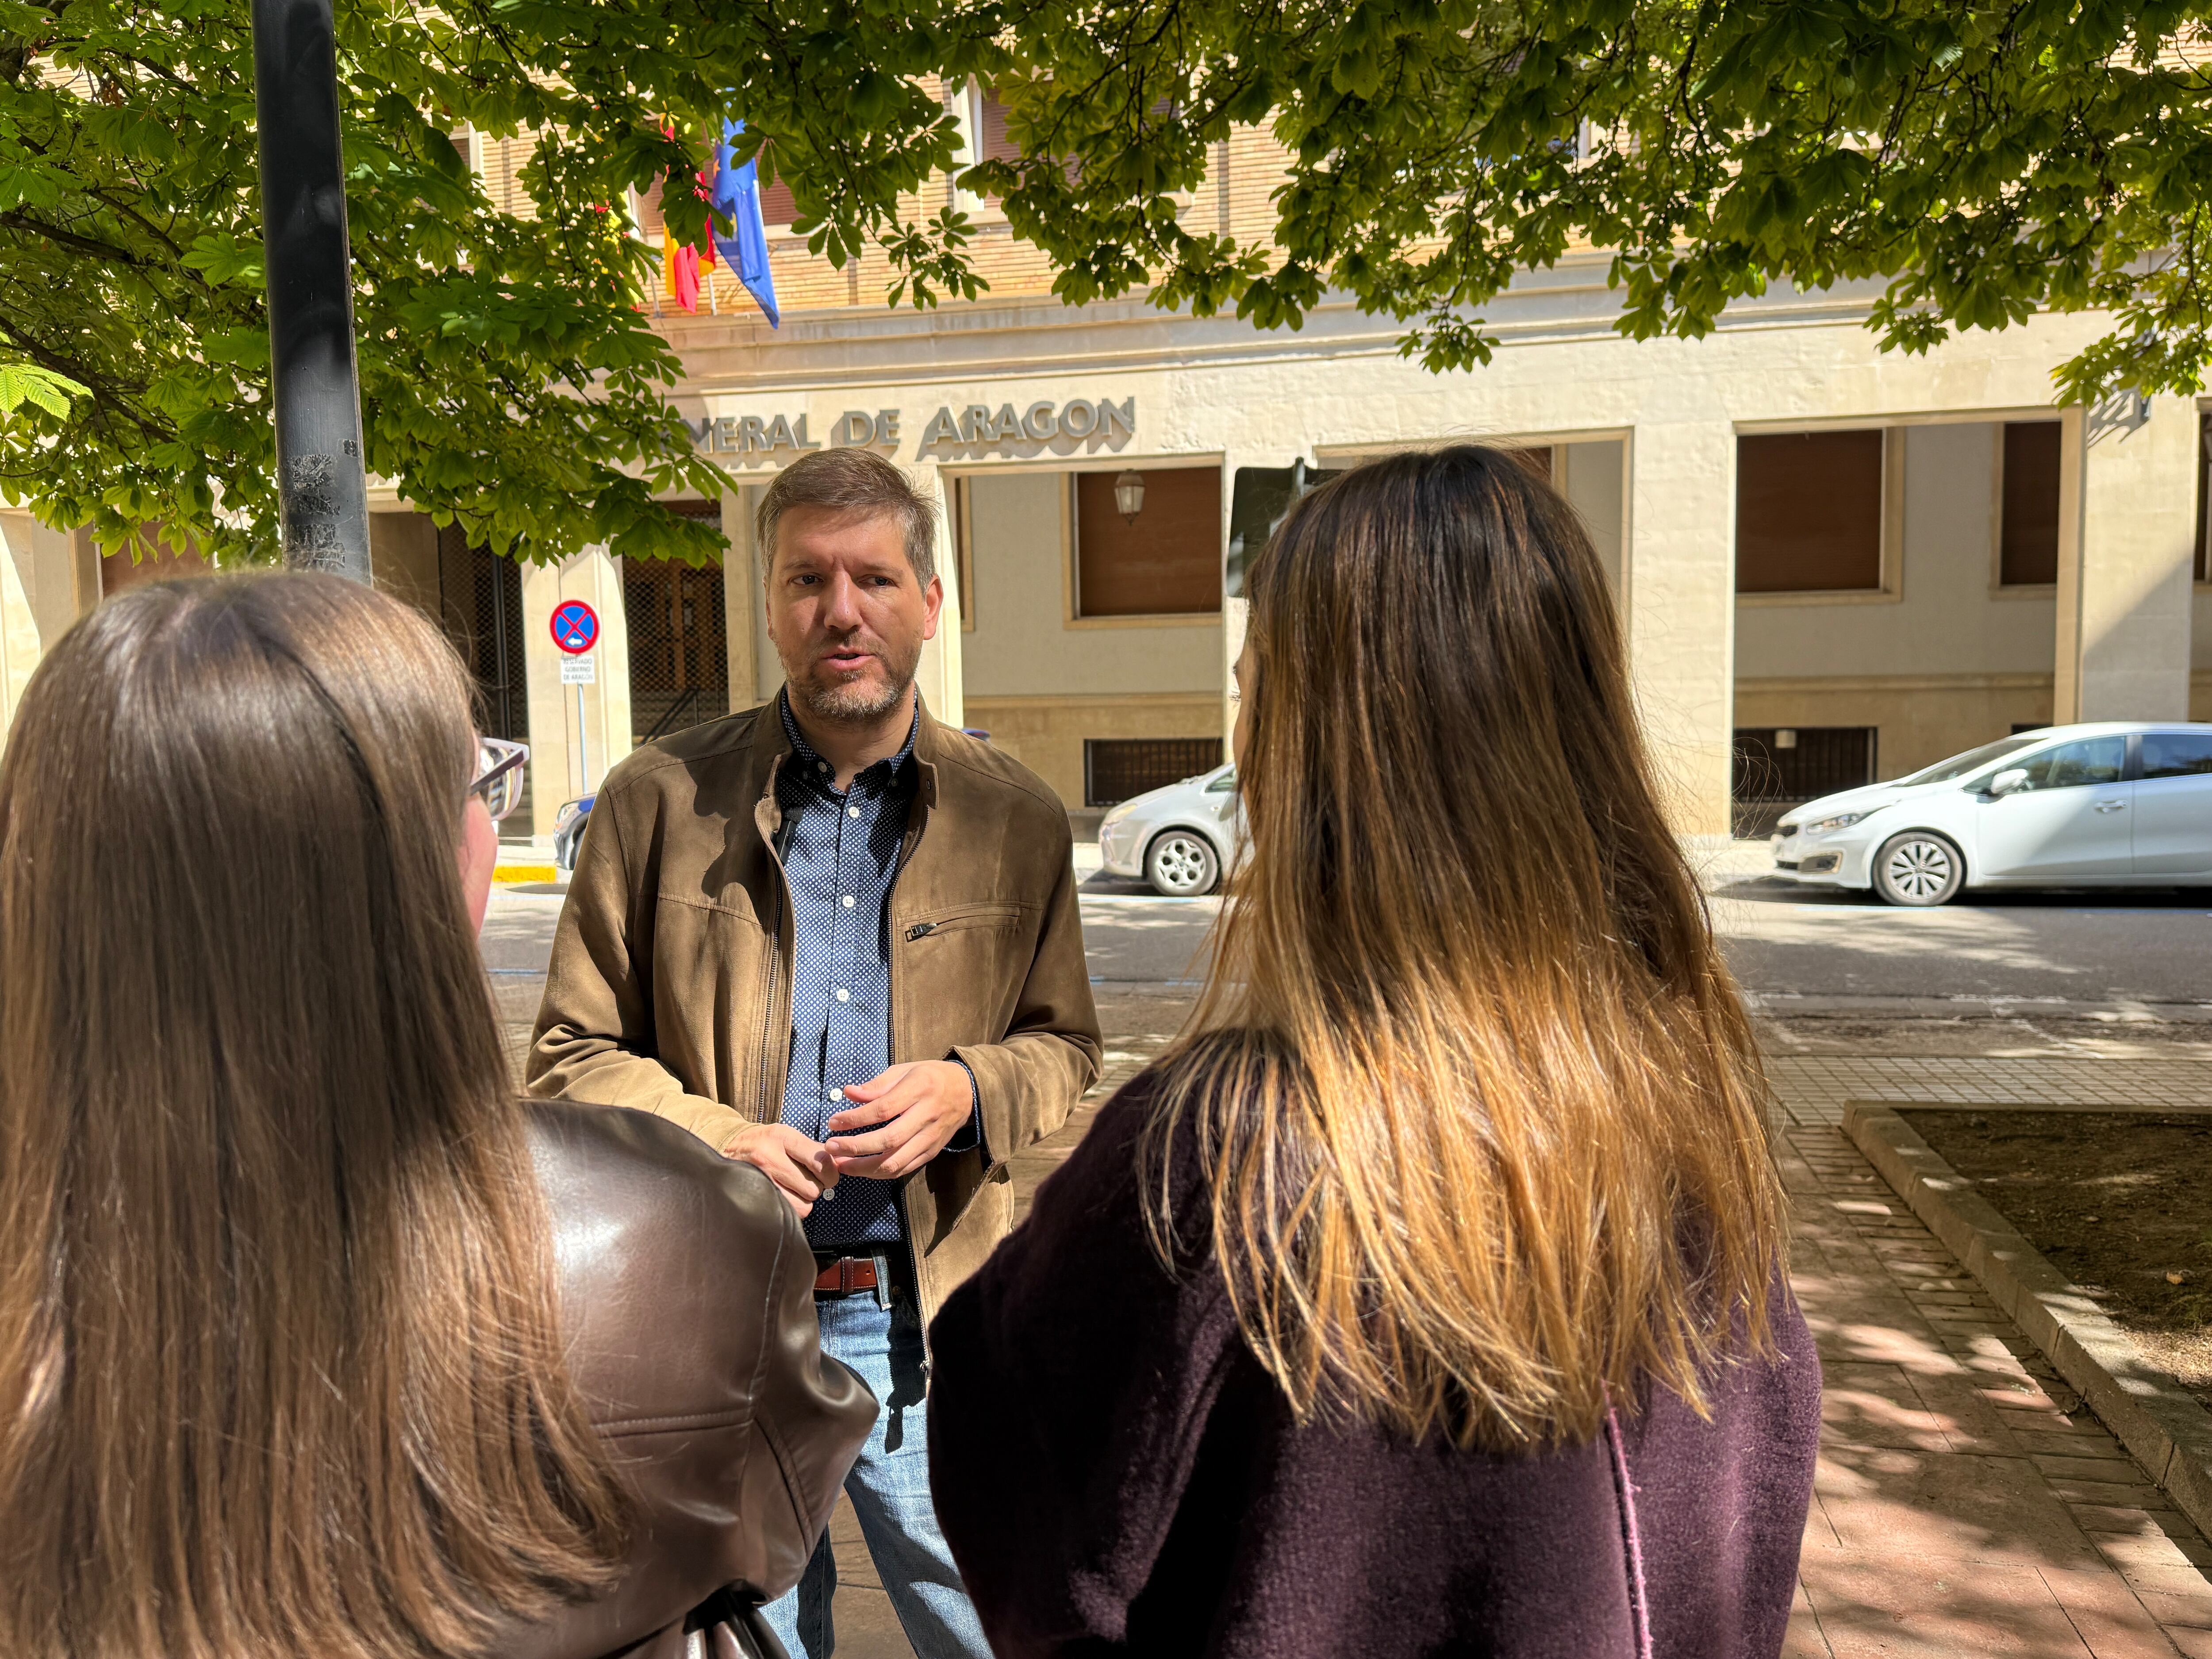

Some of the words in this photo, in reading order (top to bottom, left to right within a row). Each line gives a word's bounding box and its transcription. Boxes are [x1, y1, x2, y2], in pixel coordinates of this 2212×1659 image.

[657, 413, 822, 453] NERAL
[843, 408, 901, 446] DE
[926, 396, 1135, 445] ARAGON
